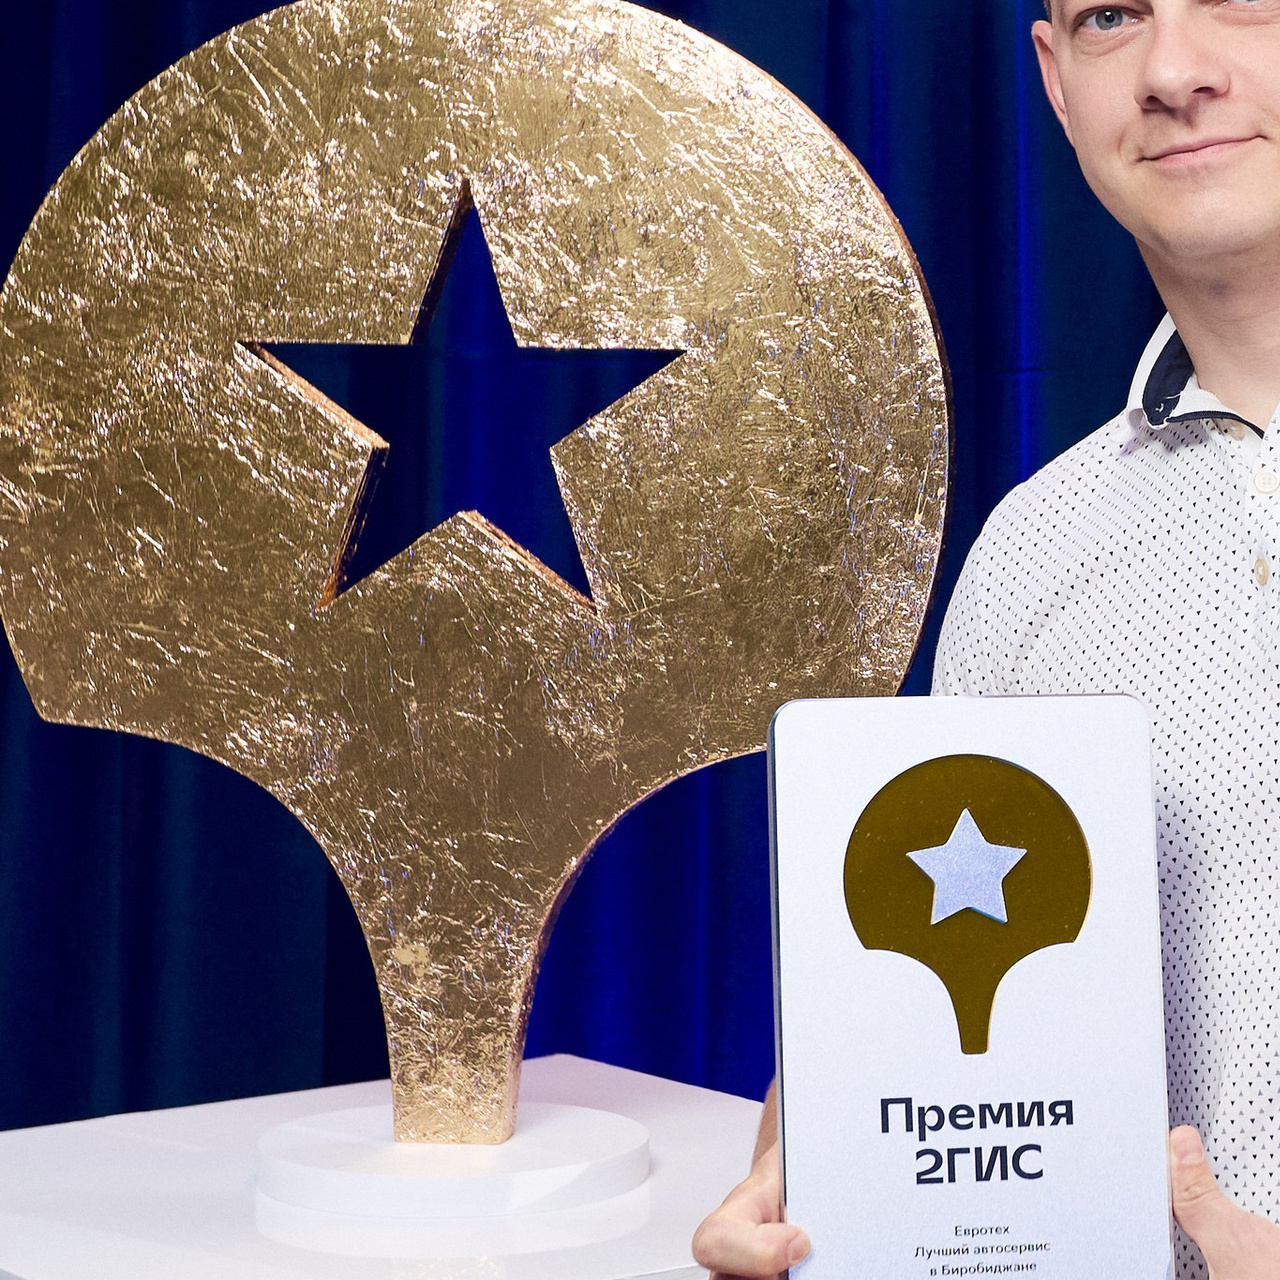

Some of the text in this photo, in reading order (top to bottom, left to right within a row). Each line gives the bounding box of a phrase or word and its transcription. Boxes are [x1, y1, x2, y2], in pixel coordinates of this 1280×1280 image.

[880, 1097, 1074, 1142] Премия
[915, 1143, 1044, 1185] 2ГИС
[954, 1225, 1010, 1238] Евротех
[914, 1241, 1051, 1259] Лучший автосервис
[929, 1260, 1037, 1277] в Биробиджане
